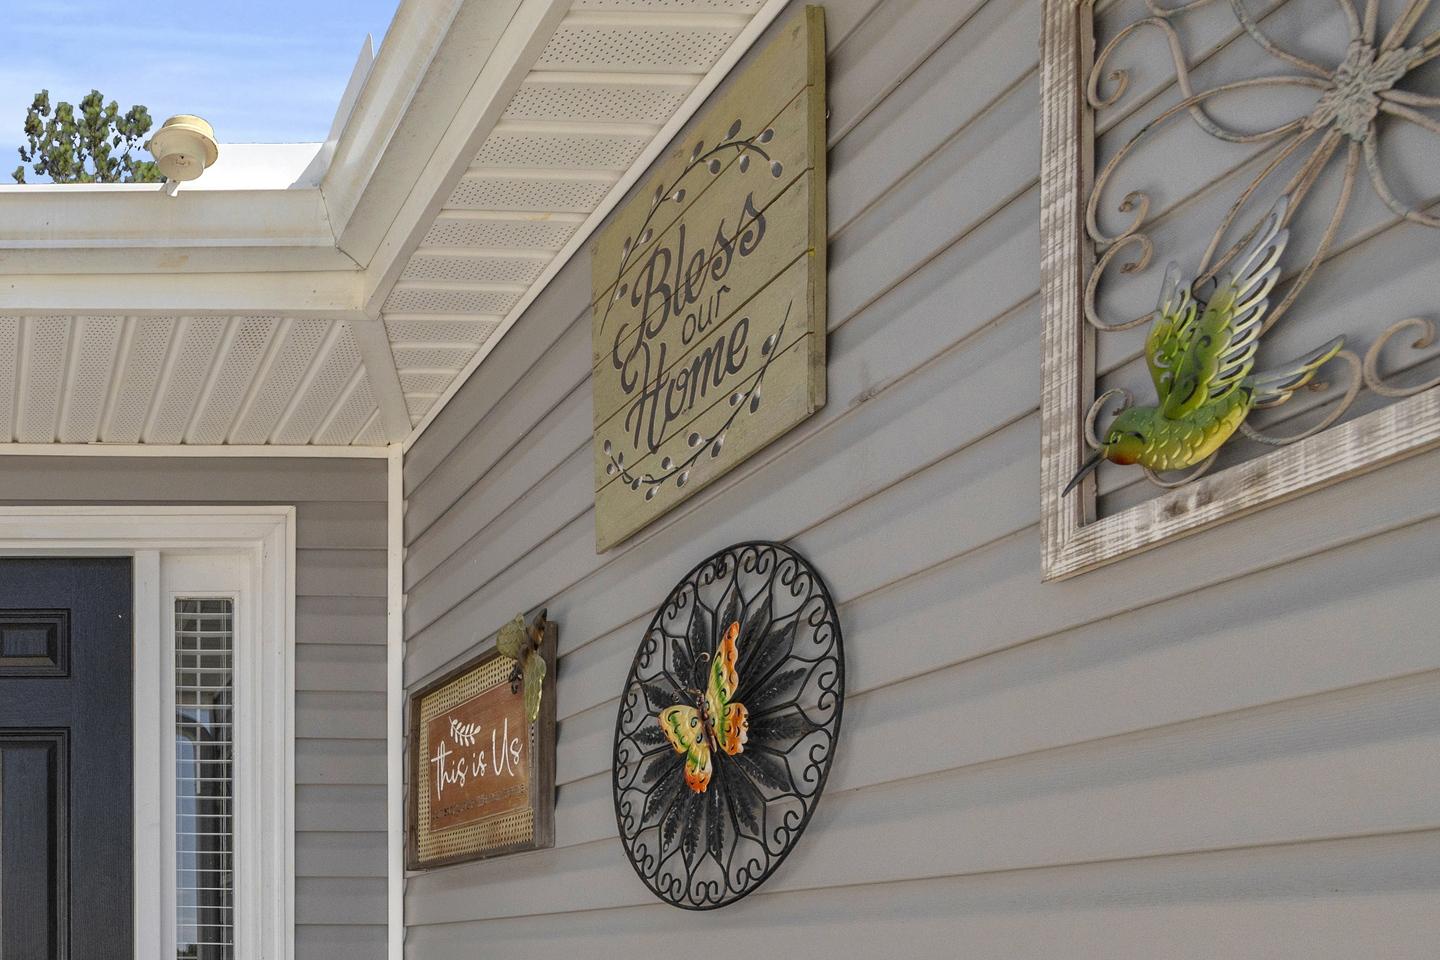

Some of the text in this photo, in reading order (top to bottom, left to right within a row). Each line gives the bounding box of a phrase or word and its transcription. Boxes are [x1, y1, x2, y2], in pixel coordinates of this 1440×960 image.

[613, 190, 766, 370] Bless
[681, 285, 731, 345] our
[621, 317, 750, 455] Home
[431, 717, 524, 801] this is Us
